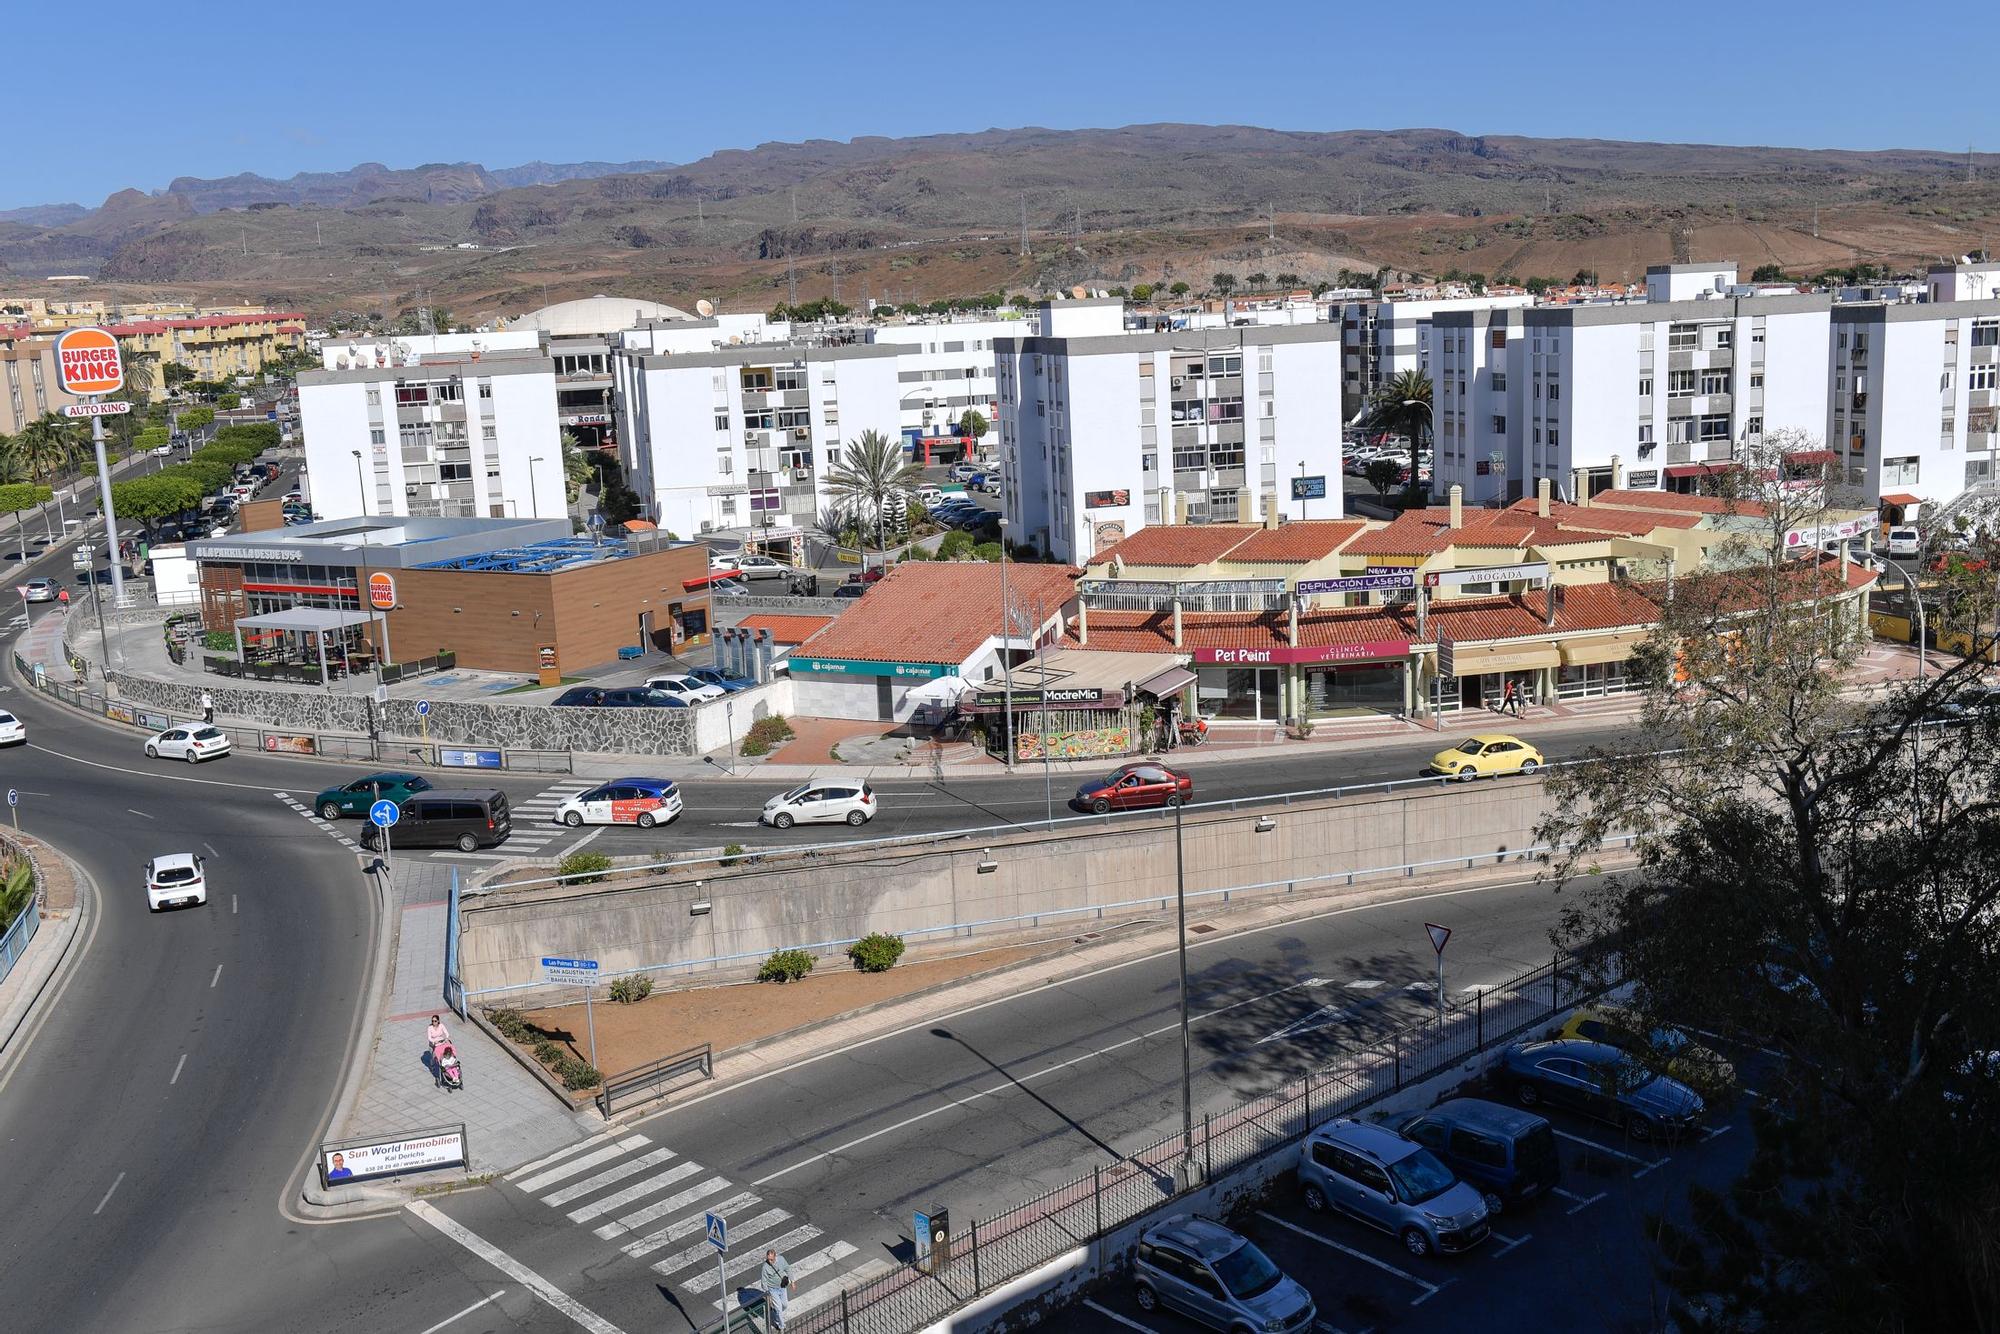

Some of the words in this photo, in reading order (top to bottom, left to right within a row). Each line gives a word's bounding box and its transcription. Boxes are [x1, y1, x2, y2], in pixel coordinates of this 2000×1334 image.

[62, 349, 117, 363] BURGER
[64, 361, 119, 382] KING
[70, 406, 99, 415] AUTO
[101, 403, 126, 413] KING
[214, 548, 254, 558] PARRILLA
[255, 549, 280, 560] DESDE
[281, 550, 303, 560] 1954
[1469, 571, 1523, 582] ABOGADA
[1299, 579, 1363, 590] DEPILACIÓN
[1366, 576, 1401, 586] LÁSER
[372, 591, 393, 601] KING
[1215, 649, 1235, 661] Pet
[1239, 649, 1271, 661] Point
[1321, 651, 1375, 660] VETERINARIA
[1330, 645, 1365, 654] CLÍNICA
[821, 663, 846, 671] cajamar
[905, 667, 931, 675] cajamar
[1045, 689, 1098, 701] MadreMia
[348, 1150, 368, 1160] Sun
[371, 1144, 400, 1156] World
[403, 1136, 459, 1151] Immobilien
[398, 1151, 425, 1160] Derichs
